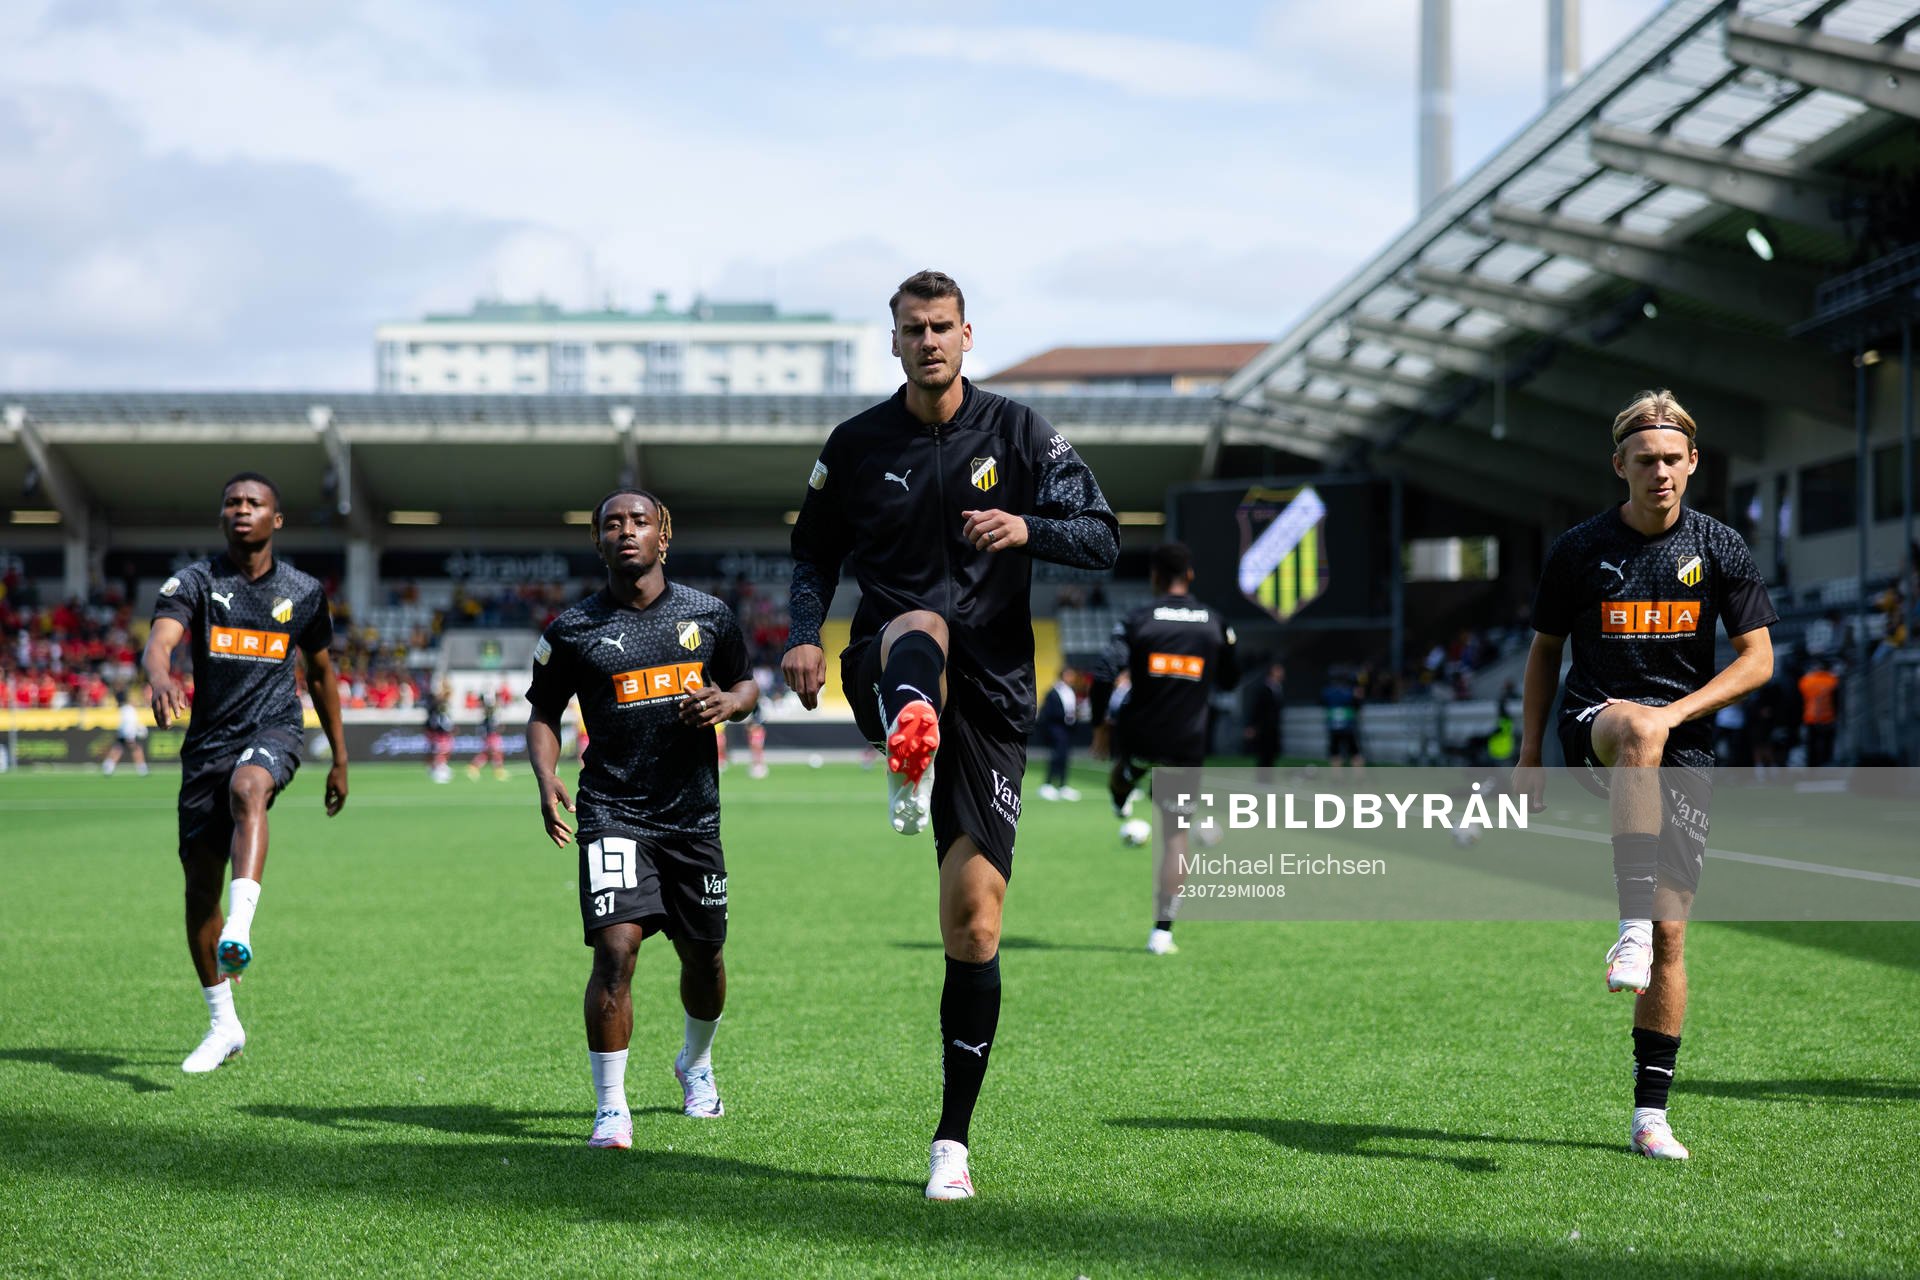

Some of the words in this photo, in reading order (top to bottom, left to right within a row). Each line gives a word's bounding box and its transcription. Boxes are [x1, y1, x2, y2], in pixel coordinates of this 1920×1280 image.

[1609, 609, 1694, 625] BRA
[217, 633, 284, 653] BRA
[622, 670, 701, 695] BRA
[595, 891, 615, 917] 37
